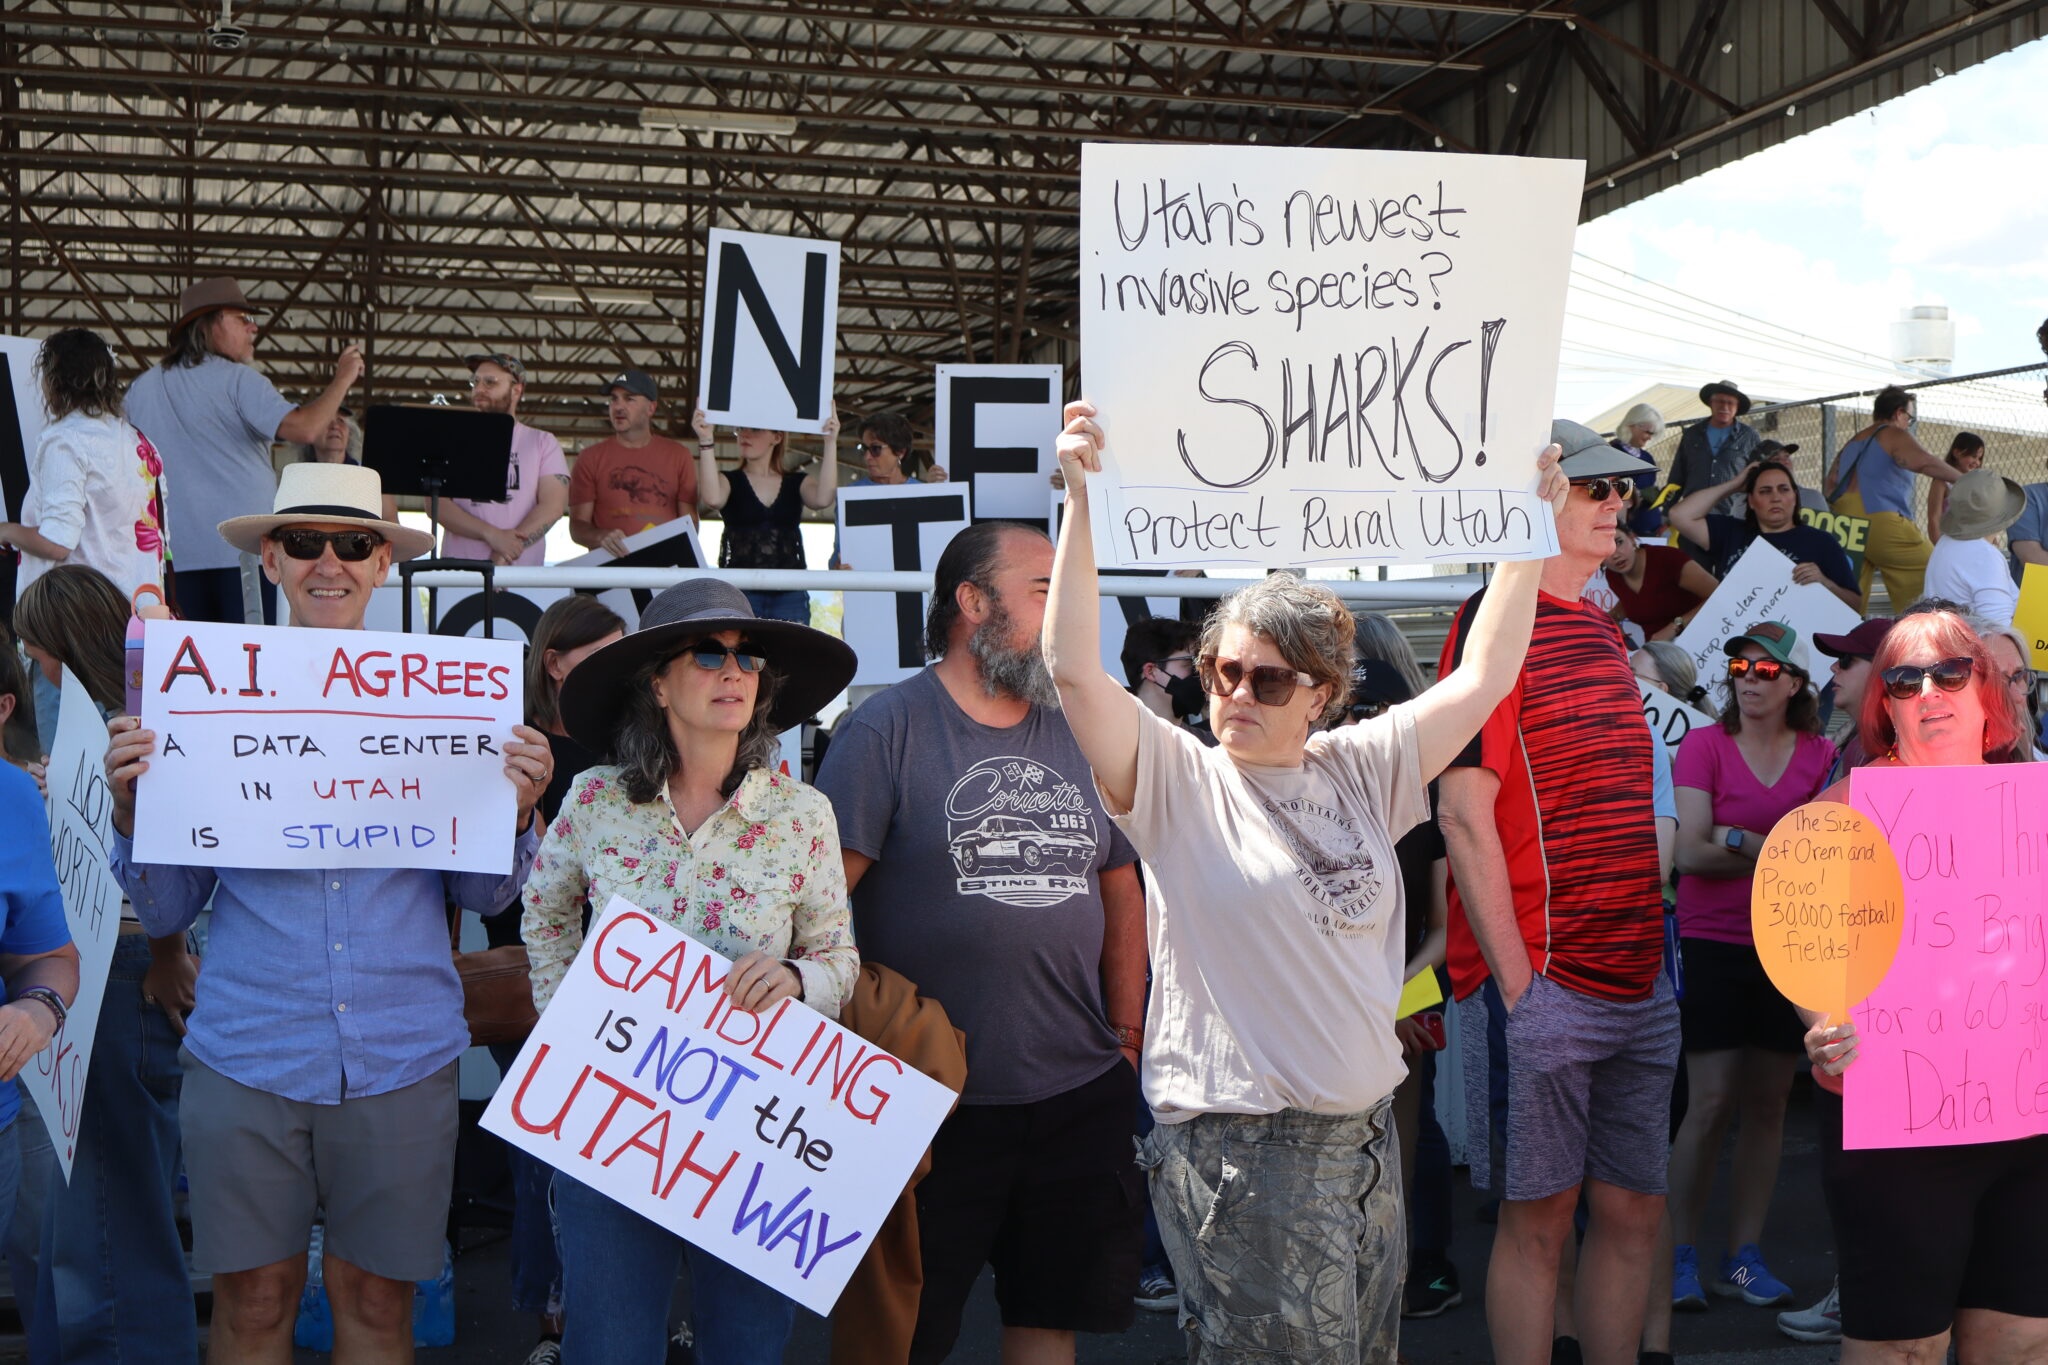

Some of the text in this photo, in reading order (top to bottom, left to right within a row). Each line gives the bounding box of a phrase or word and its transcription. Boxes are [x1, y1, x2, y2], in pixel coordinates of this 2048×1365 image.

[1114, 178, 1466, 252] Utah's newest
[1094, 250, 1453, 332] invasive species?
[707, 241, 828, 421] N
[1177, 318, 1507, 488] SHARKS!
[1302, 496, 1405, 552] Rural
[1419, 489, 1532, 548] Utah
[845, 495, 965, 668] T
[1760, 585, 1788, 618] more
[1695, 637, 1720, 669] drop
[1721, 617, 1735, 635] of
[1735, 586, 1764, 618] clean
[160, 635, 511, 700] A.I. AGREES
[163, 733, 499, 758] A DATA CENTER
[241, 778, 422, 801] IN UTAH
[945, 768, 1092, 821] Corvette
[1791, 809, 1862, 832] The Size
[192, 826, 220, 849] IS
[1050, 814, 1087, 830] 1963
[1768, 837, 1876, 863] of Orem and
[1865, 781, 2048, 881] You Thi
[1761, 867, 1825, 900] Provo!
[1769, 899, 1895, 929] 30,000 football
[1912, 899, 1955, 948] is
[593, 911, 903, 1125] GAMBLING
[1927, 1009, 1943, 1035] a
[1964, 980, 2009, 1030] 60
[594, 1009, 834, 1172] IS NOT the
[1902, 1049, 1993, 1134] Data
[511, 1043, 862, 1280] UTAH WAY
